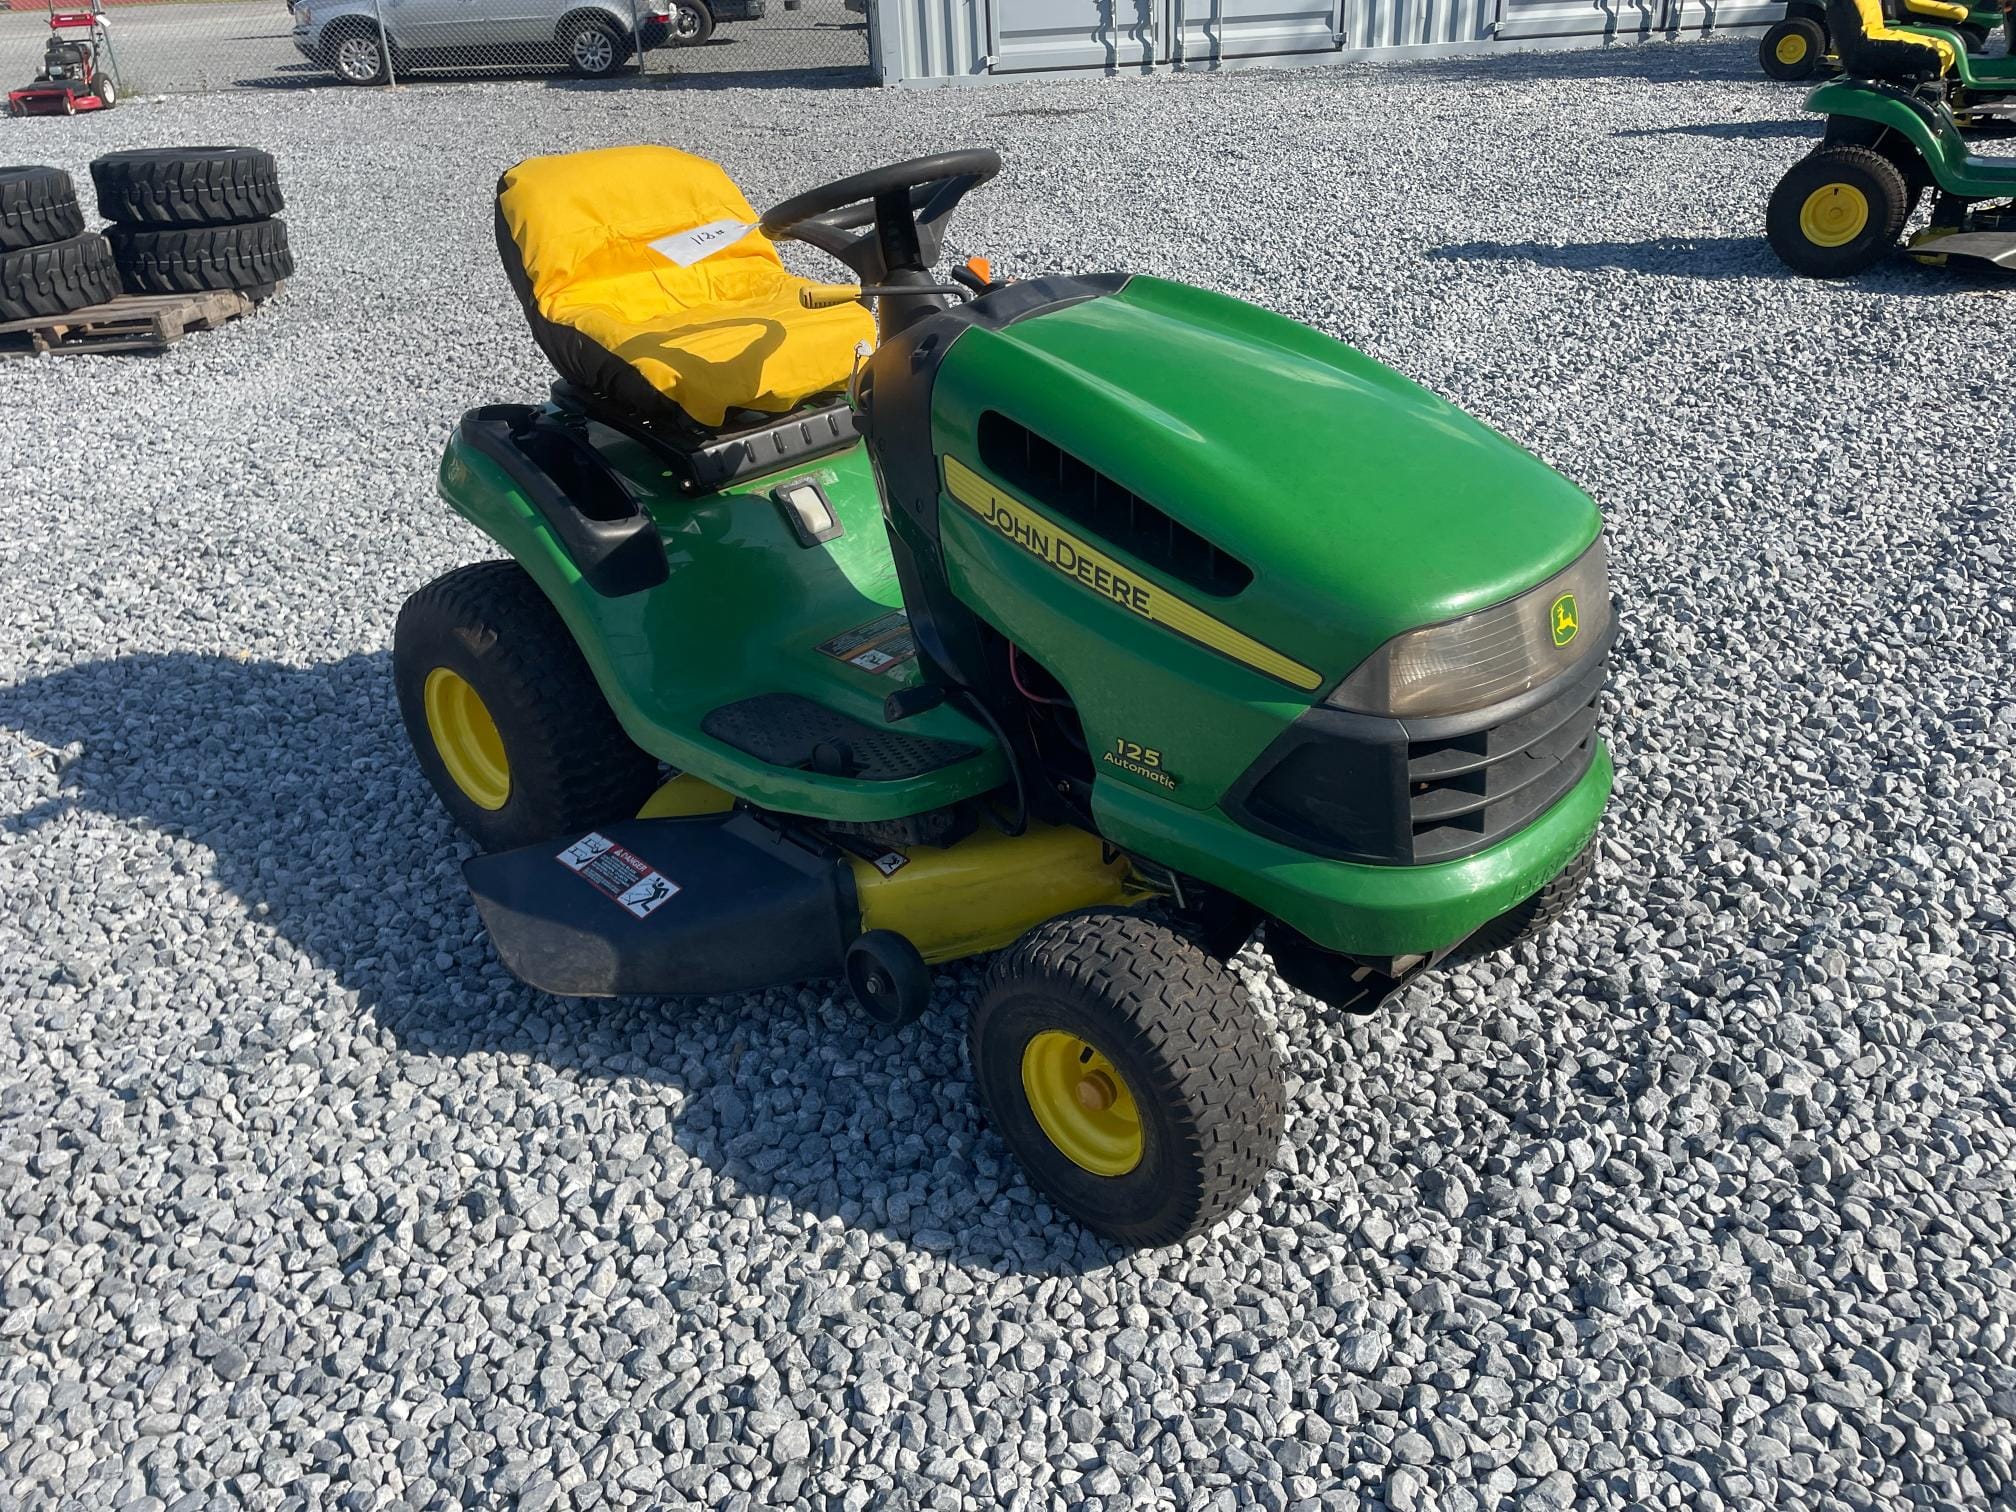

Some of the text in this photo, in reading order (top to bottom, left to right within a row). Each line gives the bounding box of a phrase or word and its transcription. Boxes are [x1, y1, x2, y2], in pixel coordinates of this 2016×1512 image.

[983, 496, 1151, 615] JOHN DEERE
[1117, 738, 1160, 767] 125
[1103, 752, 1176, 790] Automatic
[620, 851, 648, 873] DANGER
